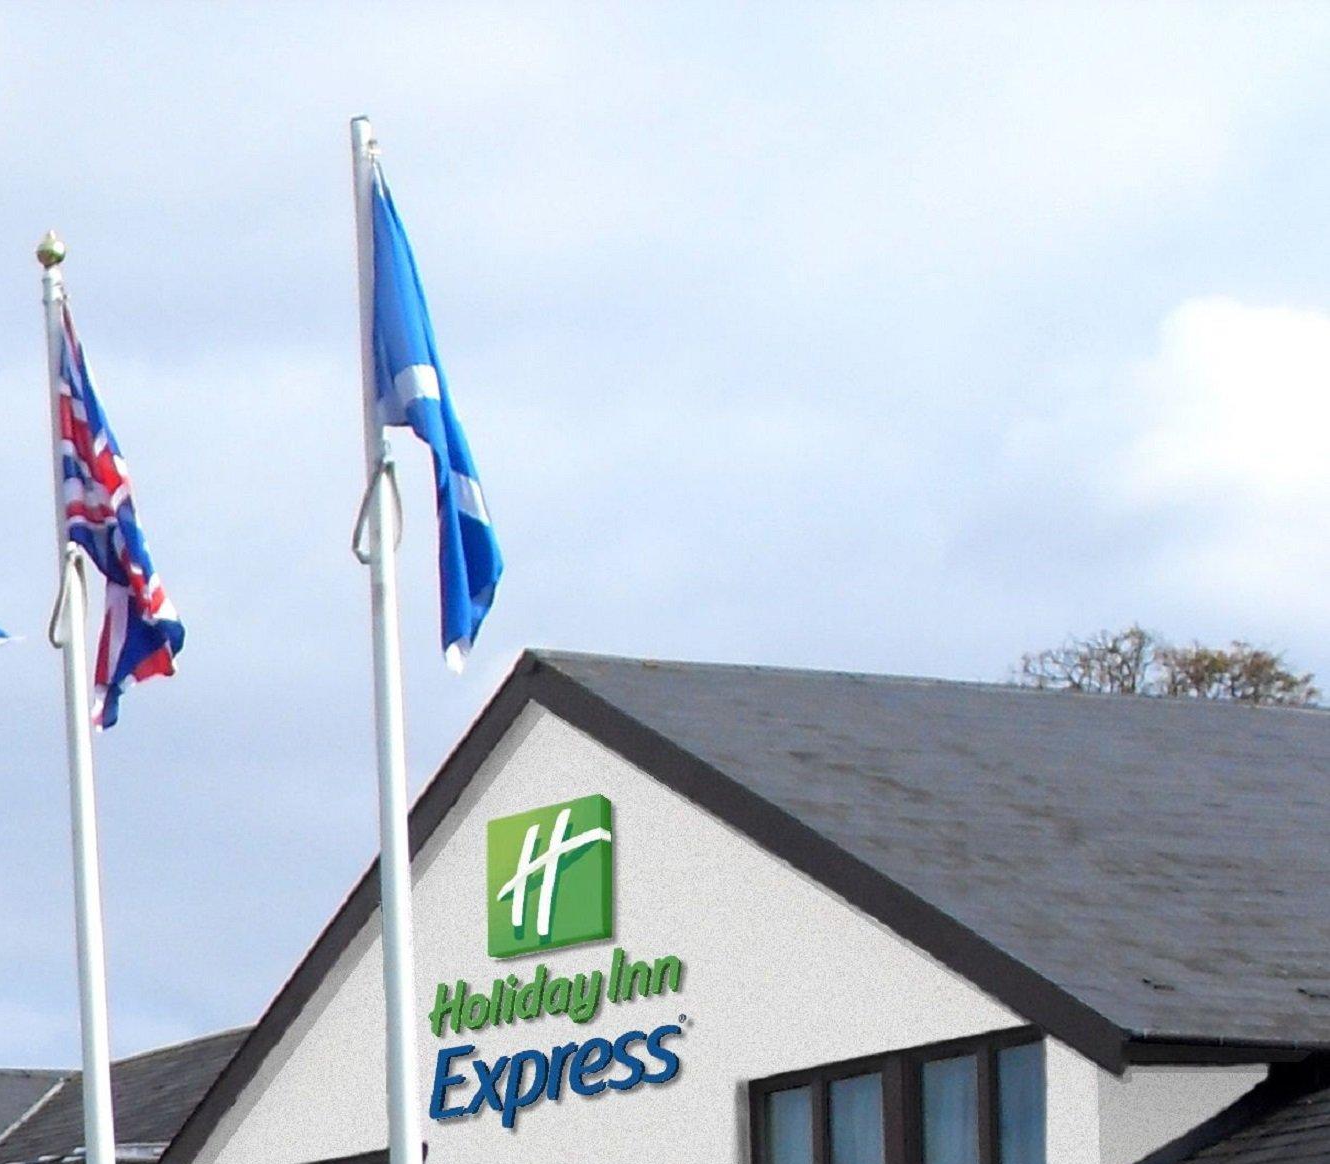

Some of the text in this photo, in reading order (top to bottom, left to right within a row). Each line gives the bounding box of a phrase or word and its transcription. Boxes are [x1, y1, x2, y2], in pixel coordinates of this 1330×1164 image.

[429, 947, 681, 1037] Holiday Inn
[429, 1024, 682, 1129] Express
